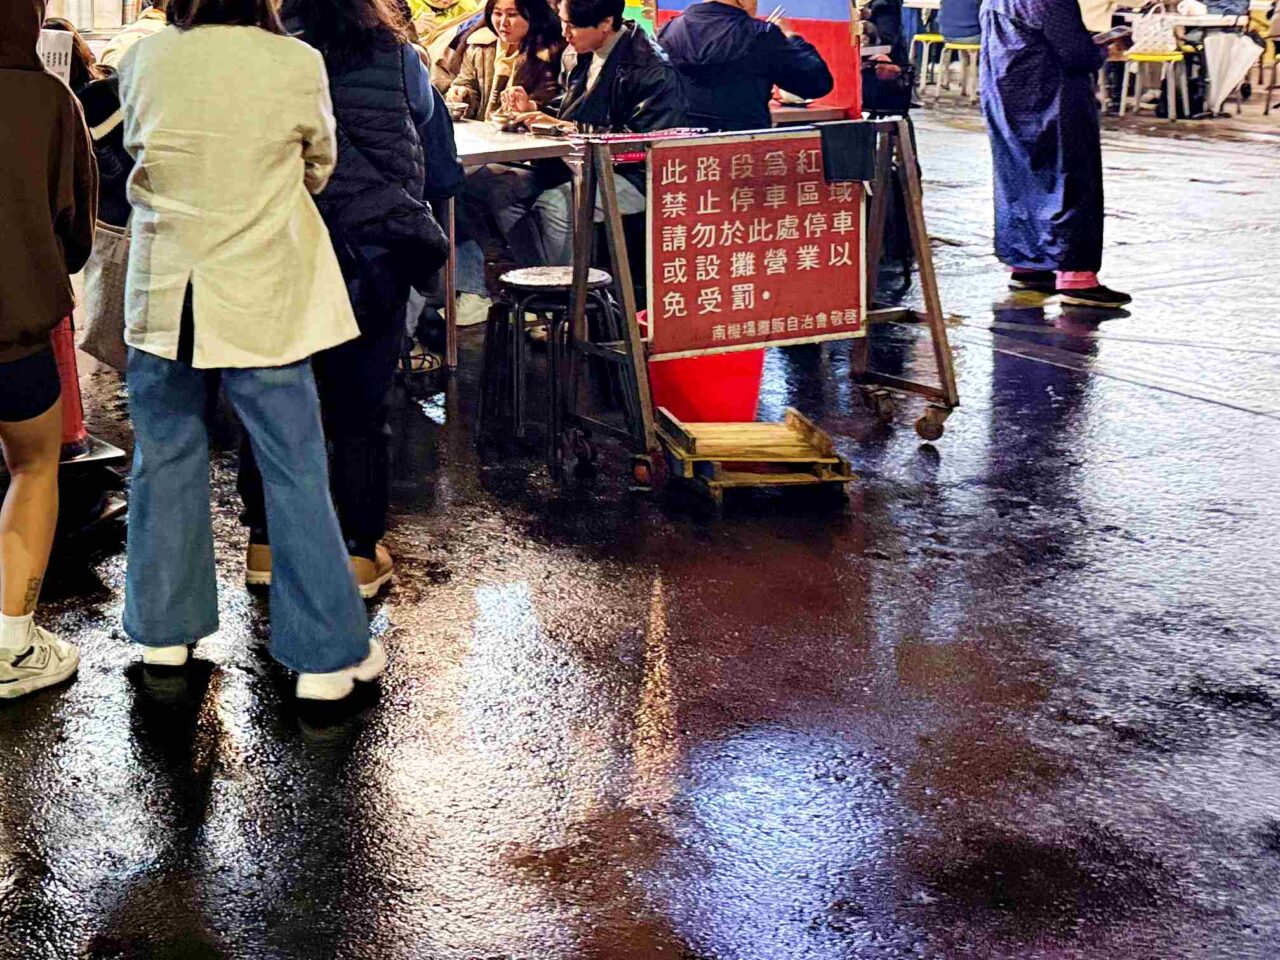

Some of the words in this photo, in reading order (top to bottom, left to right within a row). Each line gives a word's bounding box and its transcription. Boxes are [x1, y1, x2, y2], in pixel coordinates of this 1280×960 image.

[661, 181, 854, 218] 禁止停車區域
[661, 210, 856, 252] 請勿於此處停車
[662, 242, 854, 285] 或設攤營業以
